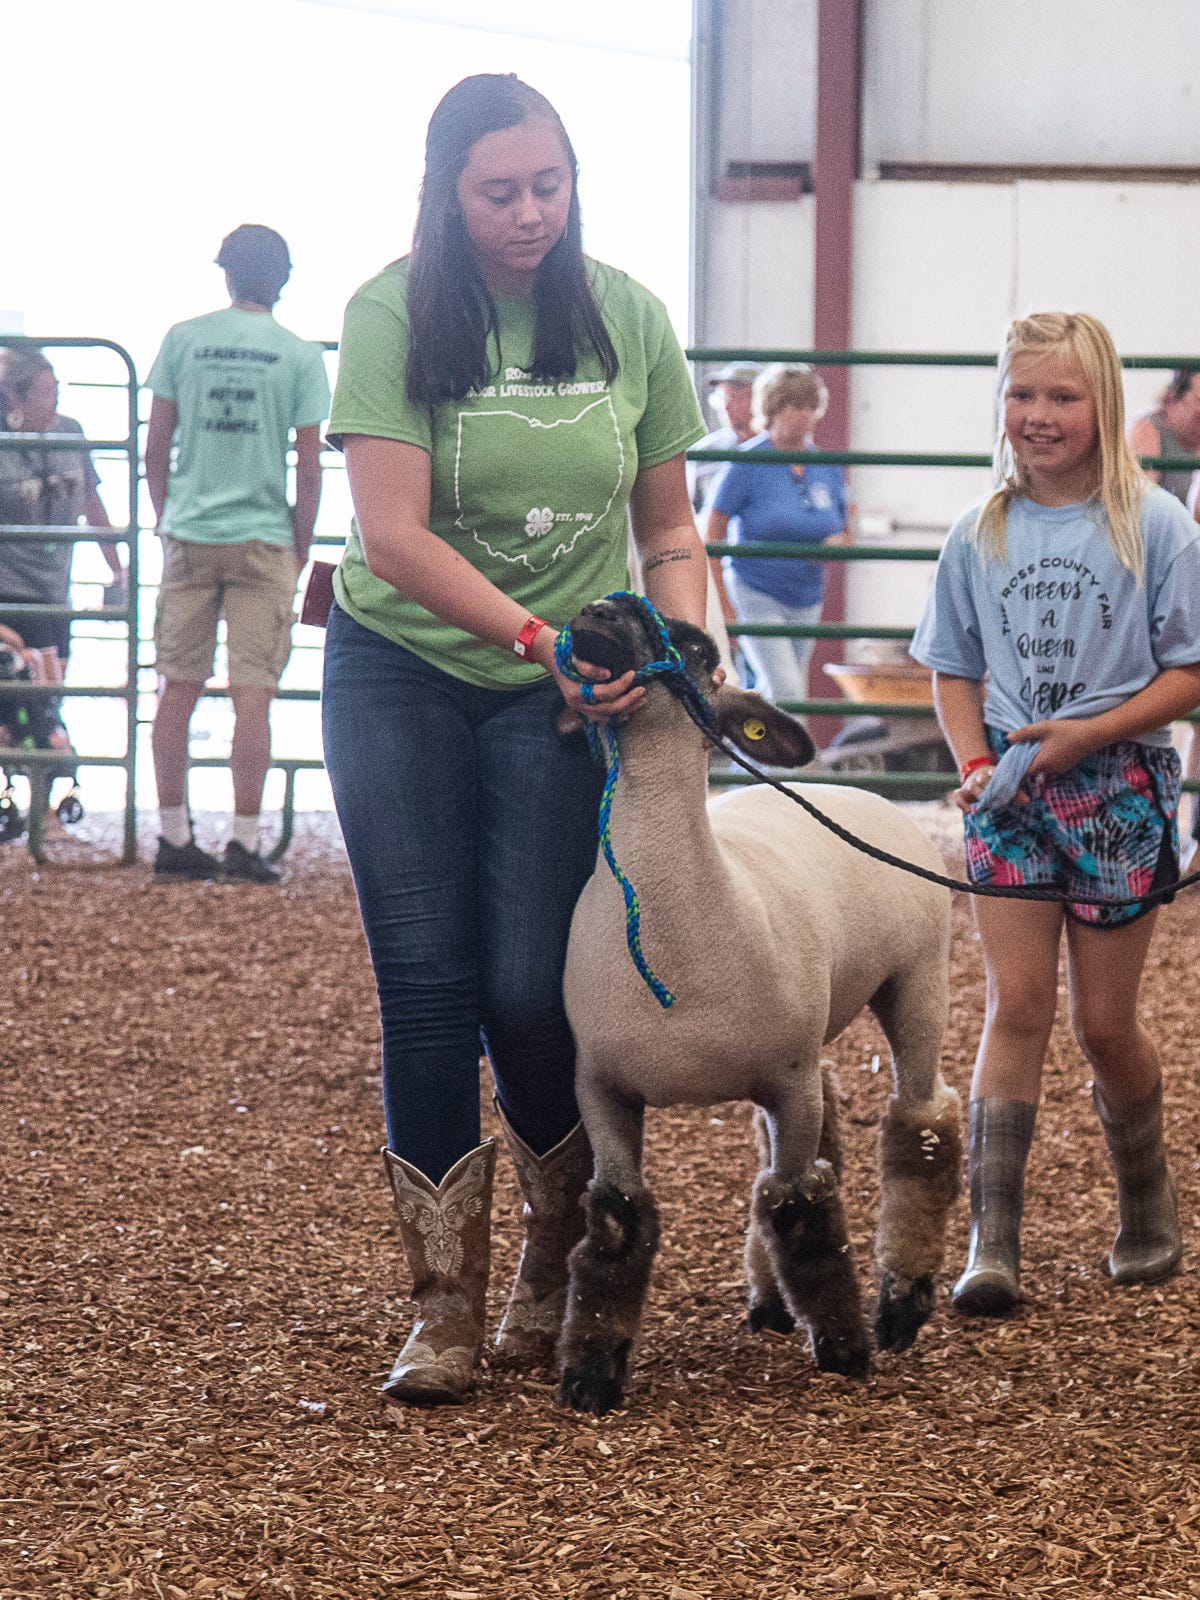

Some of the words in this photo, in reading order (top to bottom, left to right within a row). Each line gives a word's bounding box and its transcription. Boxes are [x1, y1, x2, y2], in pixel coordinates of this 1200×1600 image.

[500, 383, 556, 398] LIVESTOCK
[1001, 564, 1036, 598] ROSS
[1040, 557, 1100, 587] COUNTY
[1097, 593, 1112, 630] FAIR
[1041, 609, 1058, 629] A
